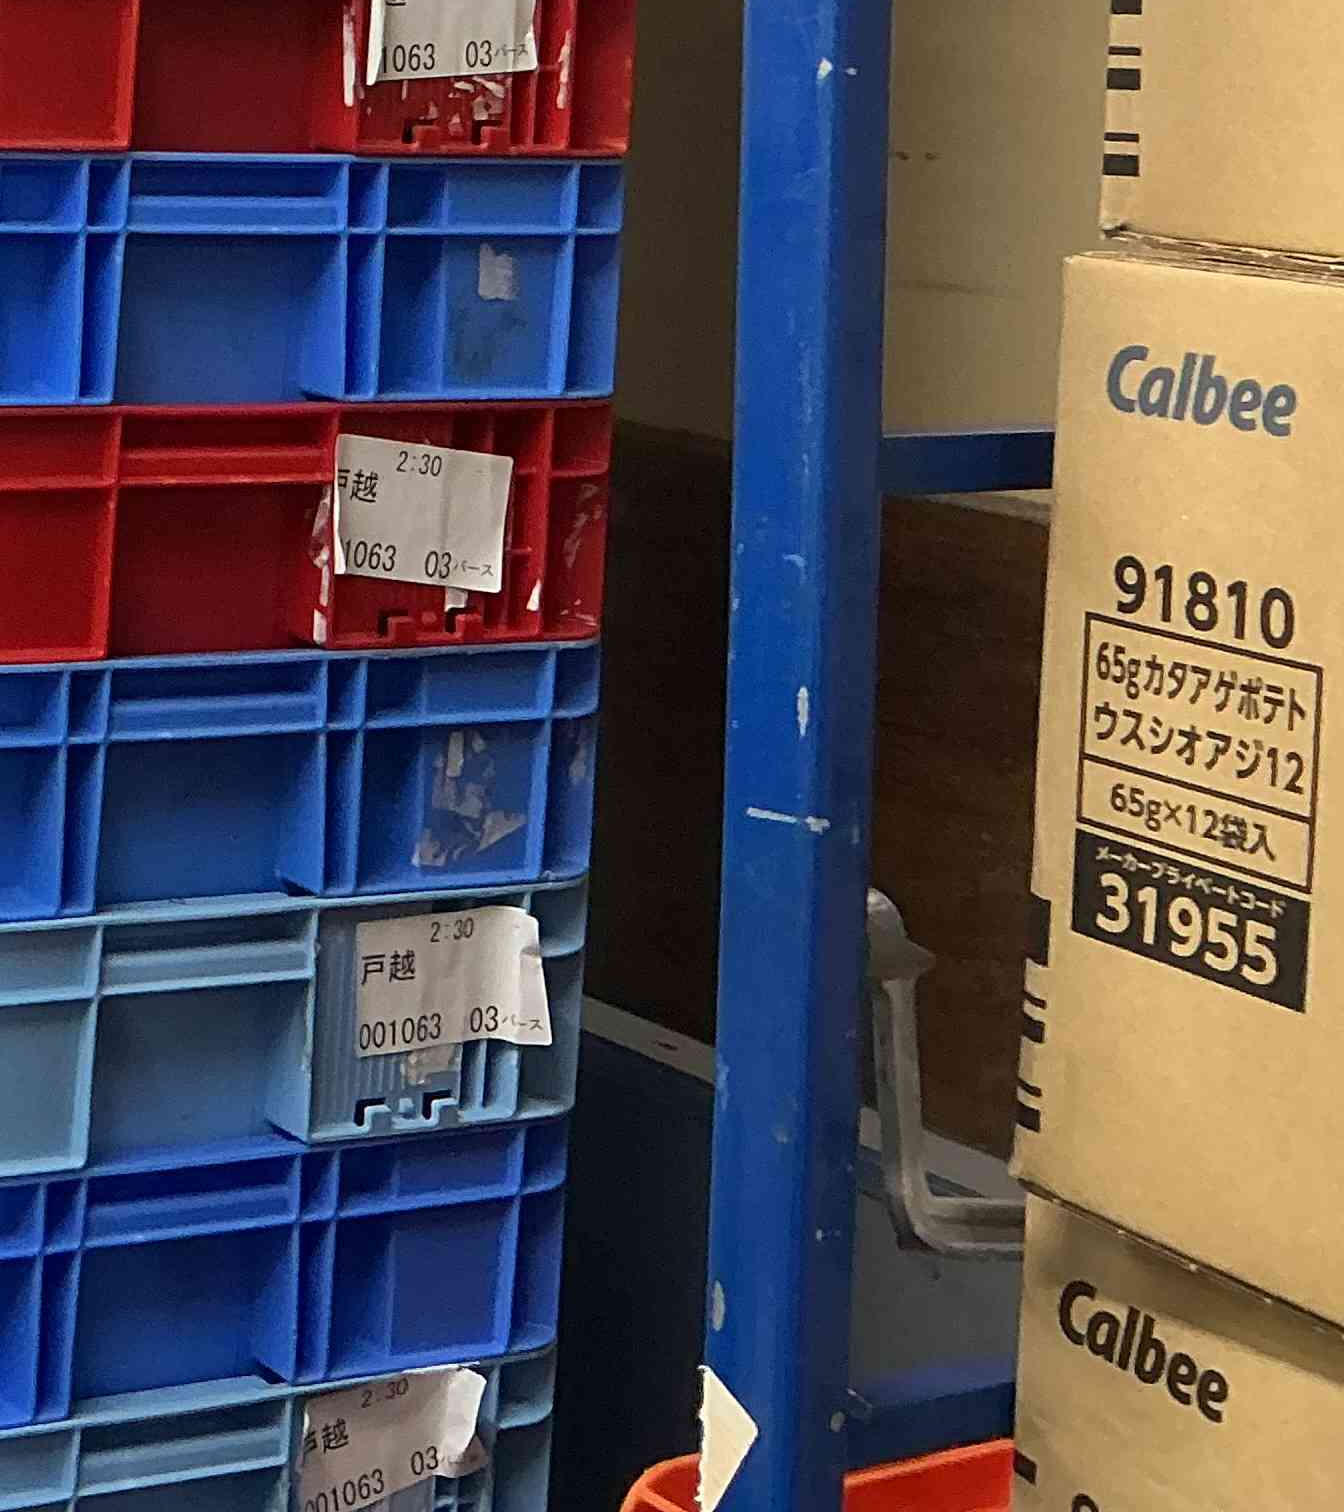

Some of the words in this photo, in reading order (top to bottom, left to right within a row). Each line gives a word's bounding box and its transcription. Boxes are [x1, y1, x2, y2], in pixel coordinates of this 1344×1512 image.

[1107, 345, 1297, 437] Calbee
[396, 451, 442, 476] 2:30
[1115, 556, 1295, 650] 91810
[1096, 642, 1306, 731] 65gカタアゲポテト
[1094, 702, 1304, 795] ウスシオアジ12
[361, 950, 416, 985] 戸越
[430, 917, 474, 943] 2:30
[1096, 873, 1278, 985] 31955
[359, 1013, 441, 1050] 001063
[1059, 1280, 1229, 1423] Calbee
